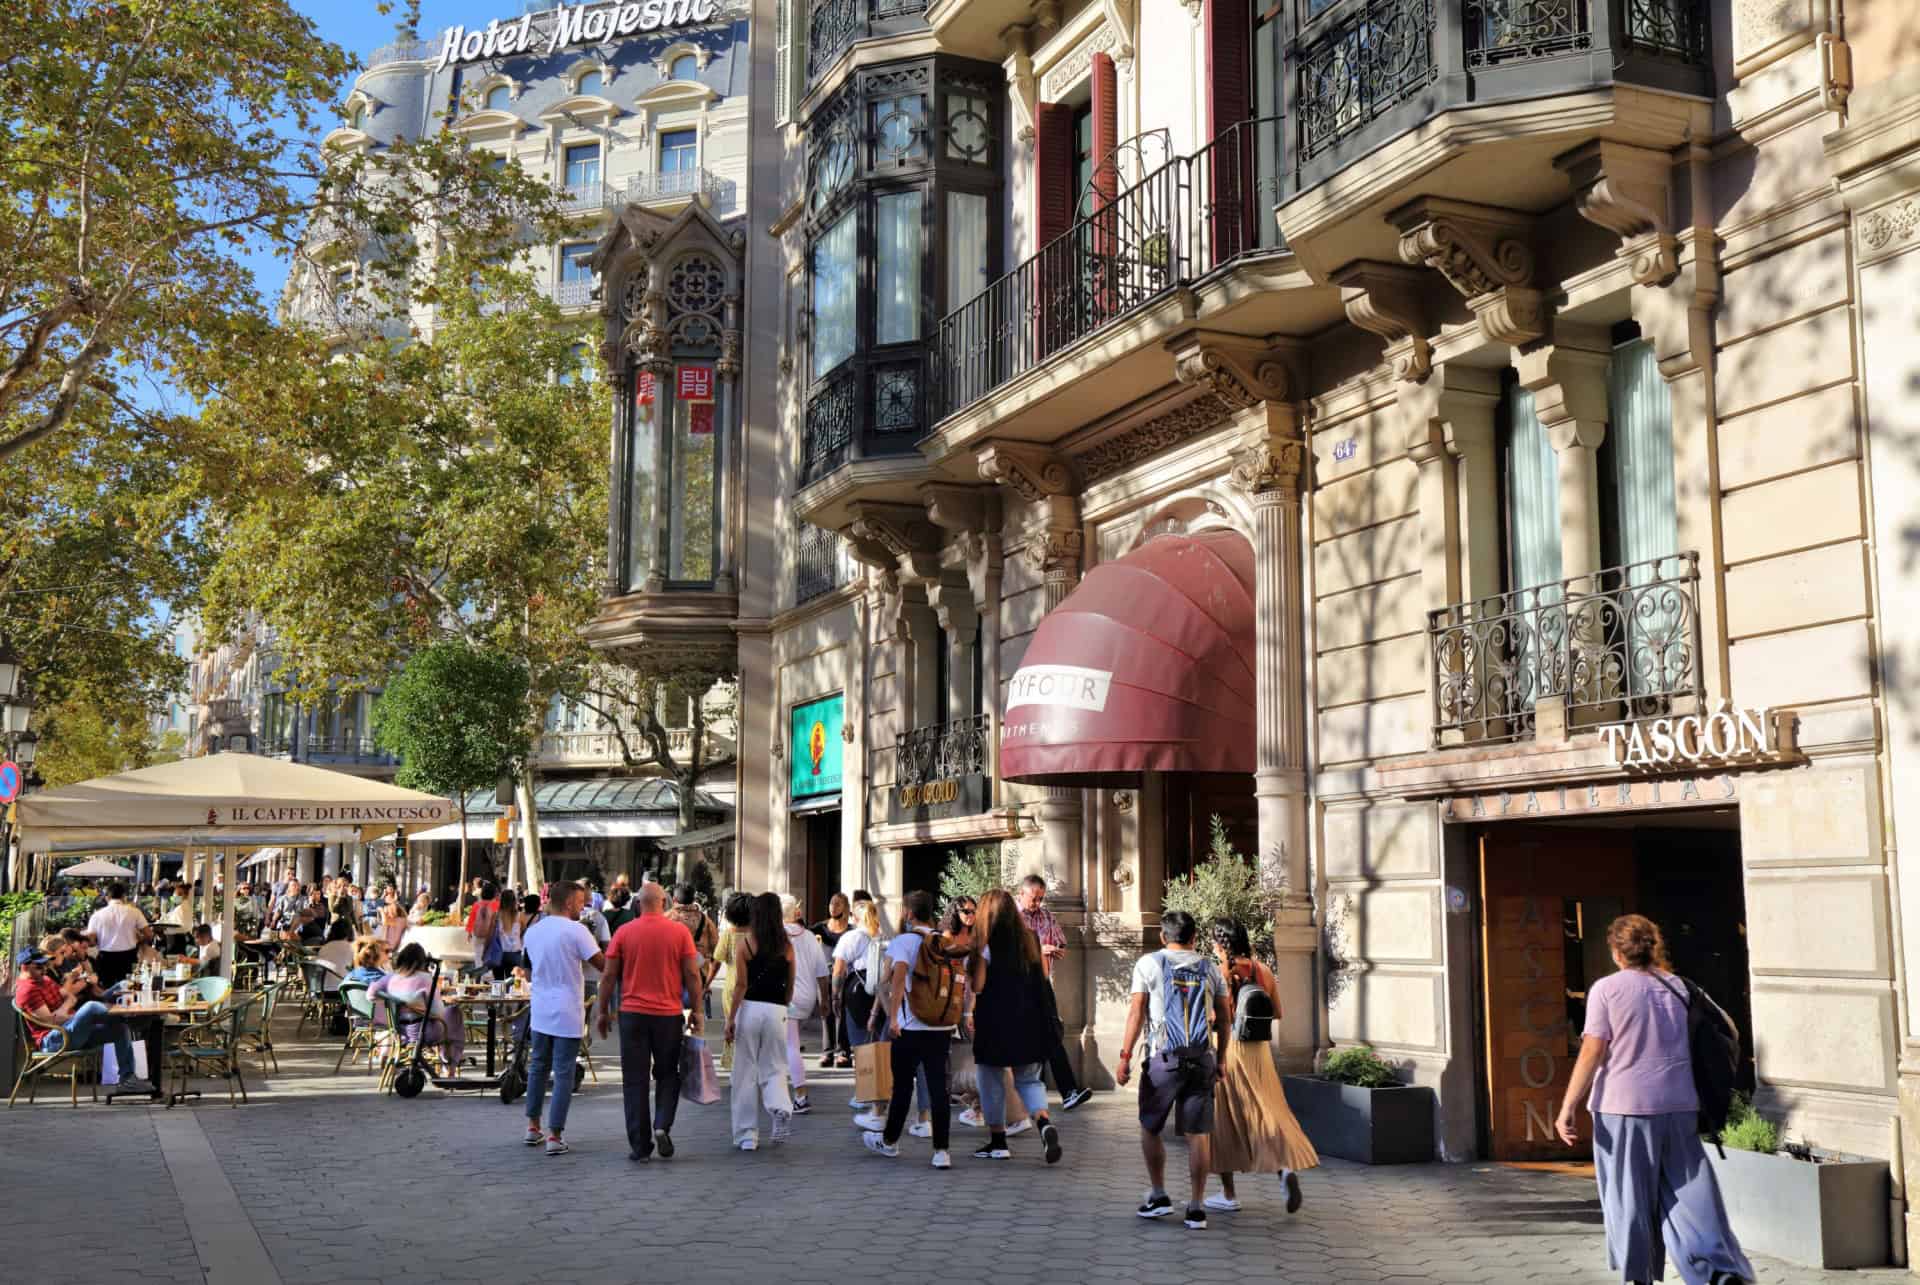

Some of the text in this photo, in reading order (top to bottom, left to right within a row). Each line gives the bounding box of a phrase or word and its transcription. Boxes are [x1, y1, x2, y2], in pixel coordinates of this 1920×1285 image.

[435, 0, 714, 73] Hotel Majestic
[1600, 699, 1769, 766] TASCÓN
[232, 806, 442, 820] IL CAFFE DI FRANCESCO
